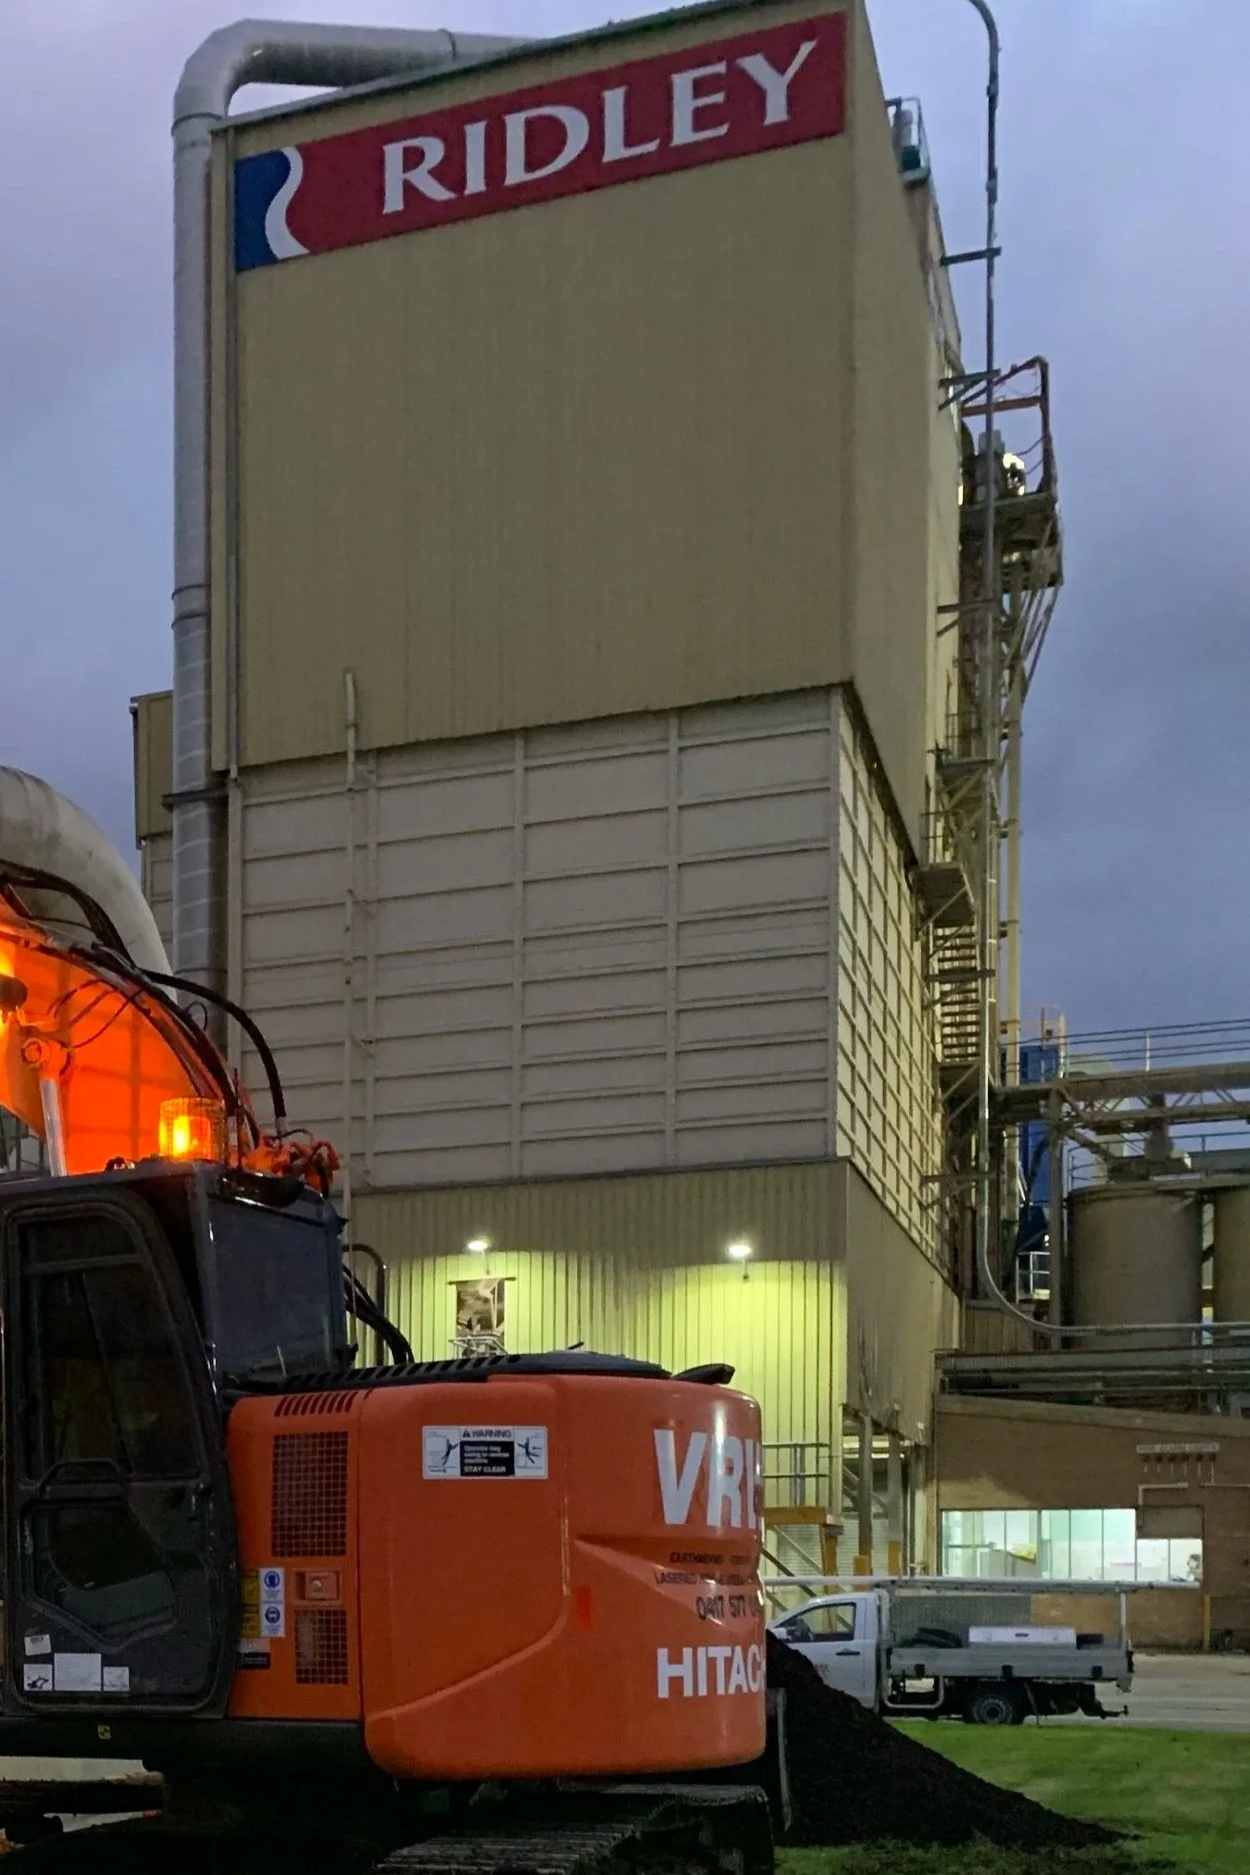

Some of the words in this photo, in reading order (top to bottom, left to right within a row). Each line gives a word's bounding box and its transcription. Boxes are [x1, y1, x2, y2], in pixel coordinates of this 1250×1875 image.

[381, 39, 819, 215] RIDLEY
[472, 1429, 512, 1438] WARNING
[463, 1465, 482, 1473] STAY
[656, 1644, 766, 1698] HITAC
